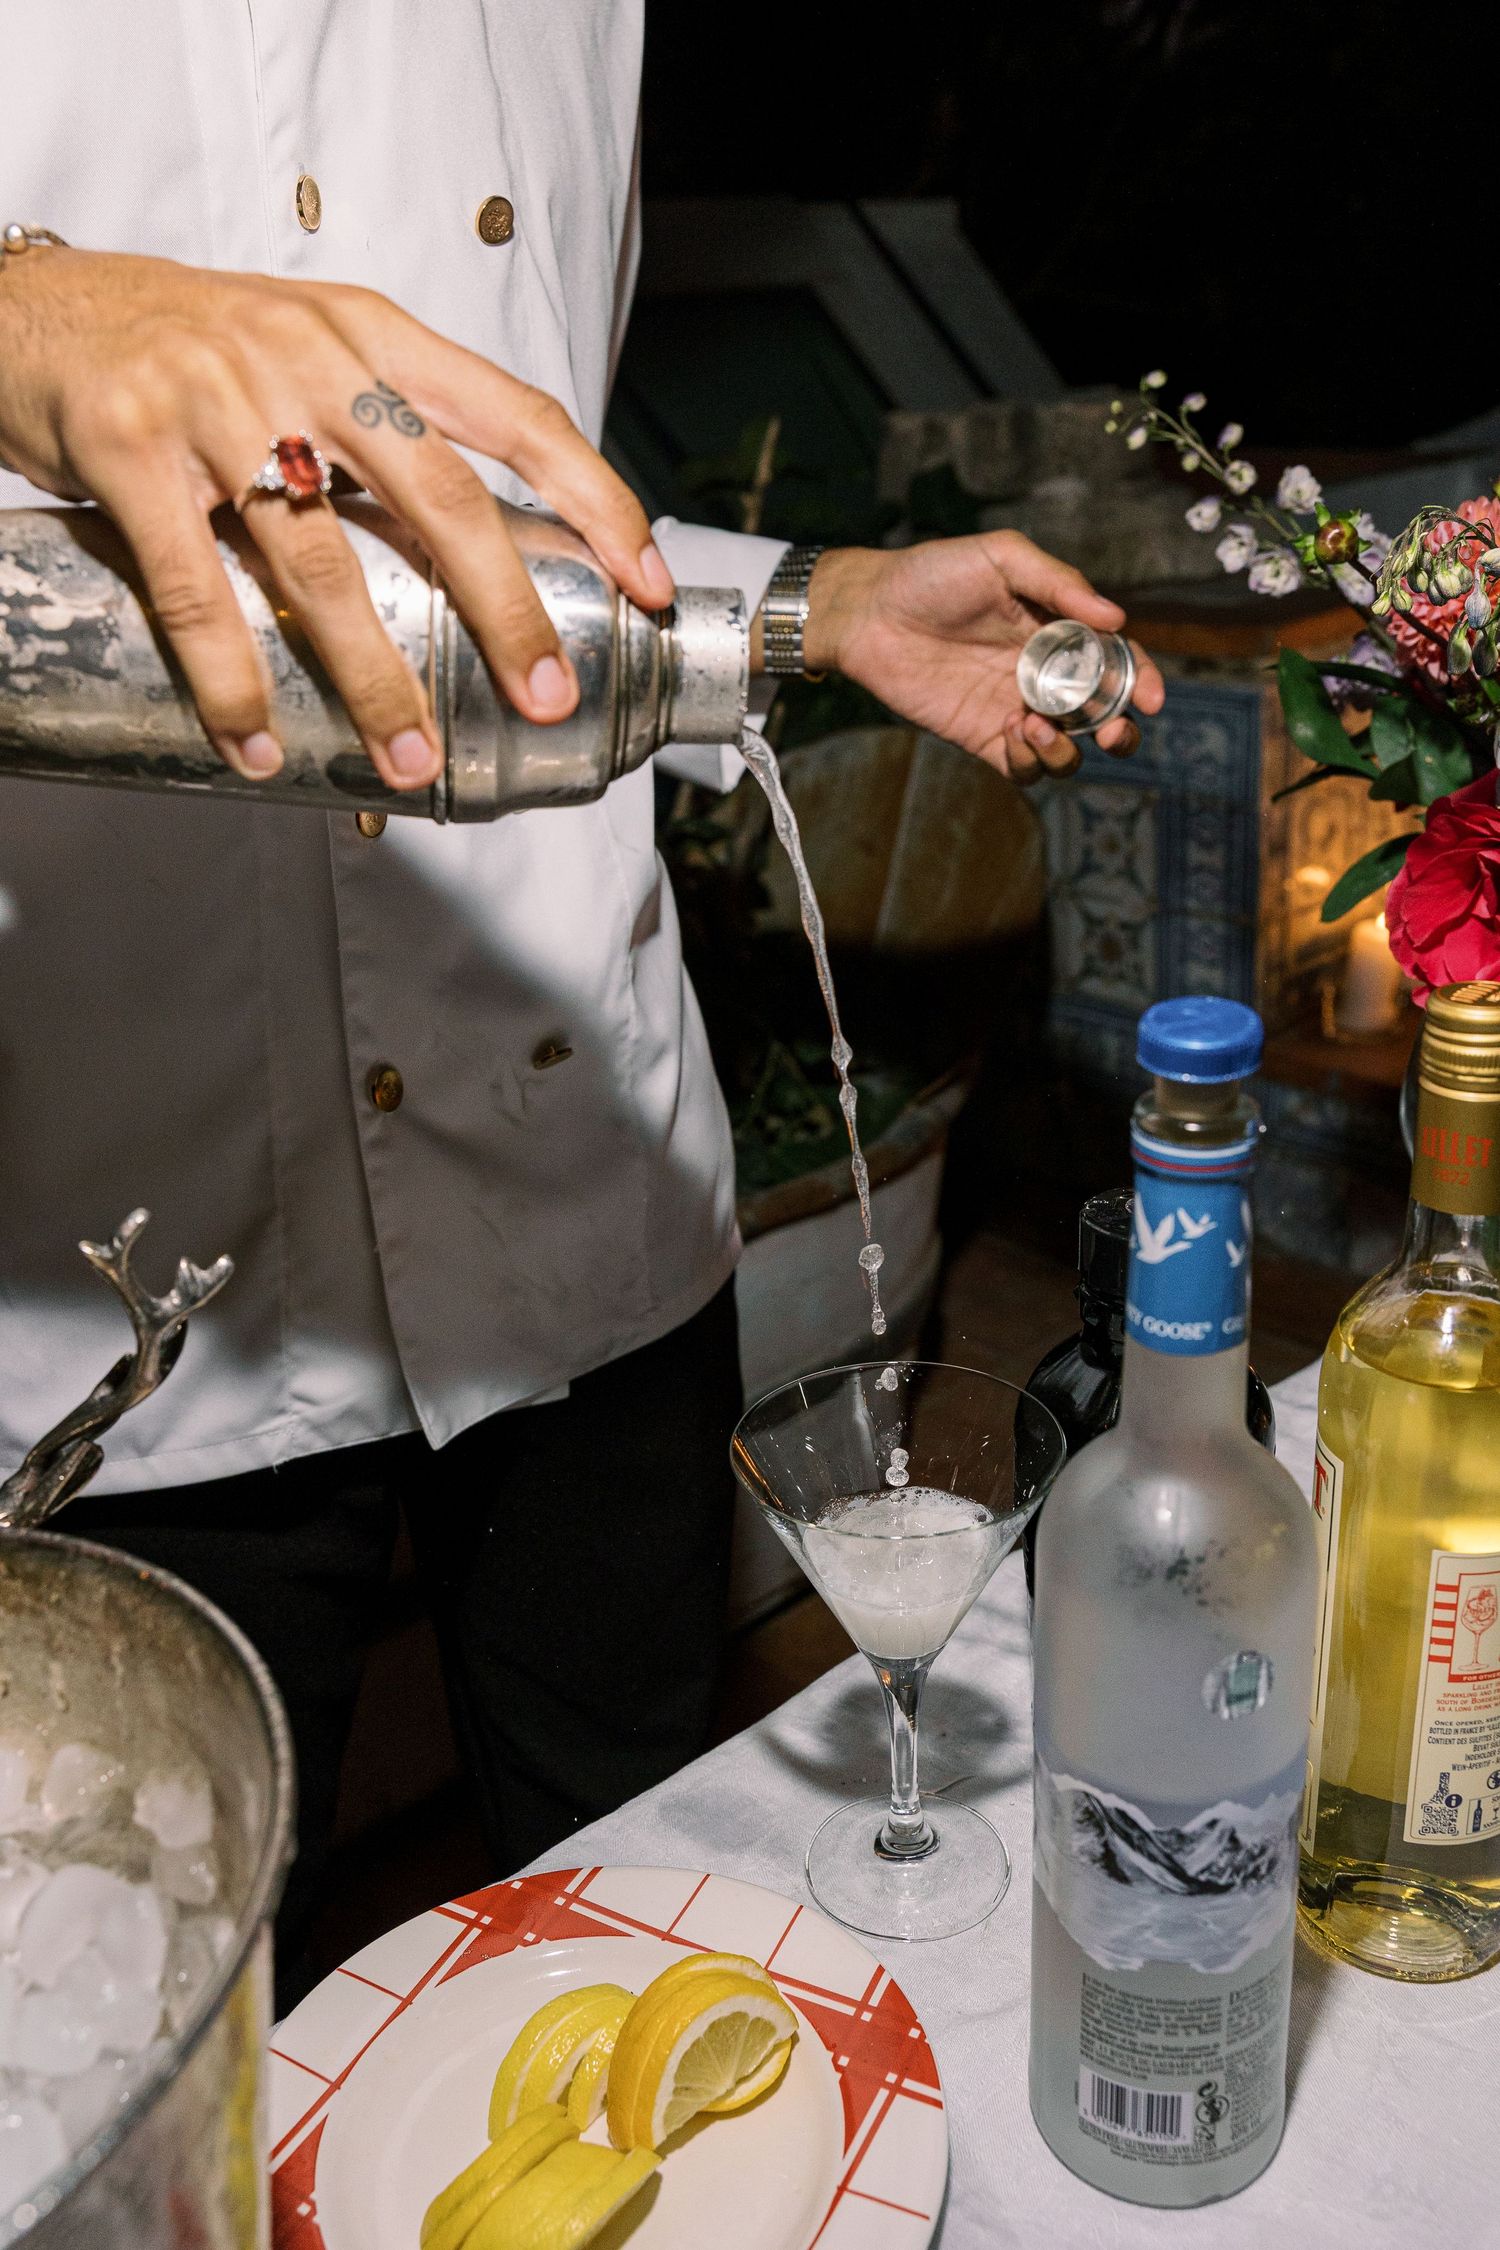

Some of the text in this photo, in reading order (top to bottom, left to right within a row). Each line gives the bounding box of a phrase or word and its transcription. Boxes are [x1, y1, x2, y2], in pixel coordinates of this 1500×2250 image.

[1142, 1316, 1206, 1340] GOOSE
[1429, 1726, 1452, 1735] BOTTLED
[1460, 1726, 1479, 1734] FRANCE
[1428, 1736, 1456, 1745] CONTIENT
[1457, 1737, 1468, 1745] DES
